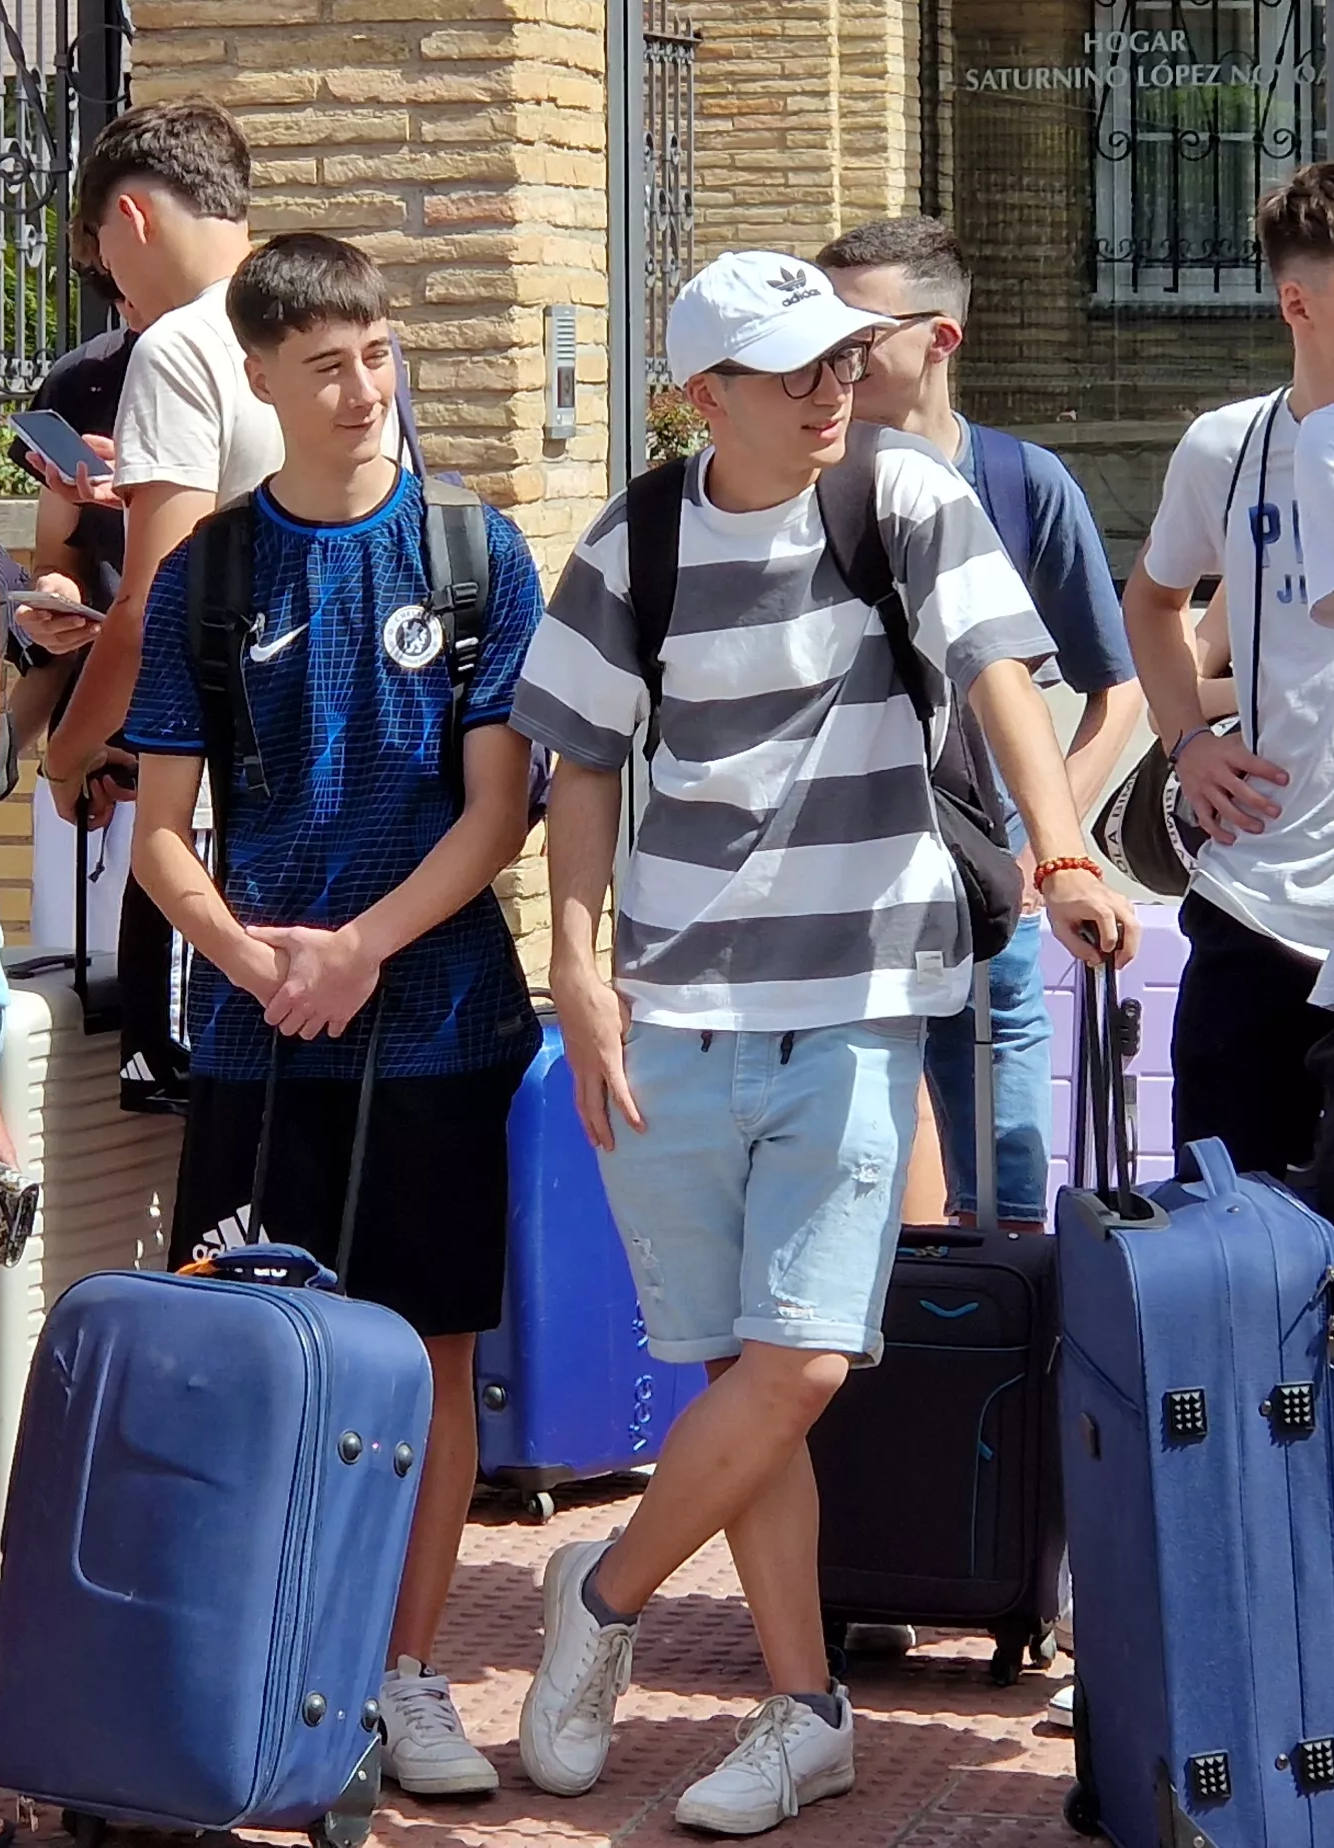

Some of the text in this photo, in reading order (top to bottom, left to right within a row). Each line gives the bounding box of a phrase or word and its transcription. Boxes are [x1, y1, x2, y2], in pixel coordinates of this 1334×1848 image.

[1084, 29, 1187, 54] HOGAR
[966, 66, 1128, 92] SATURNINO
[1137, 58, 1221, 87] LÓPEZ
